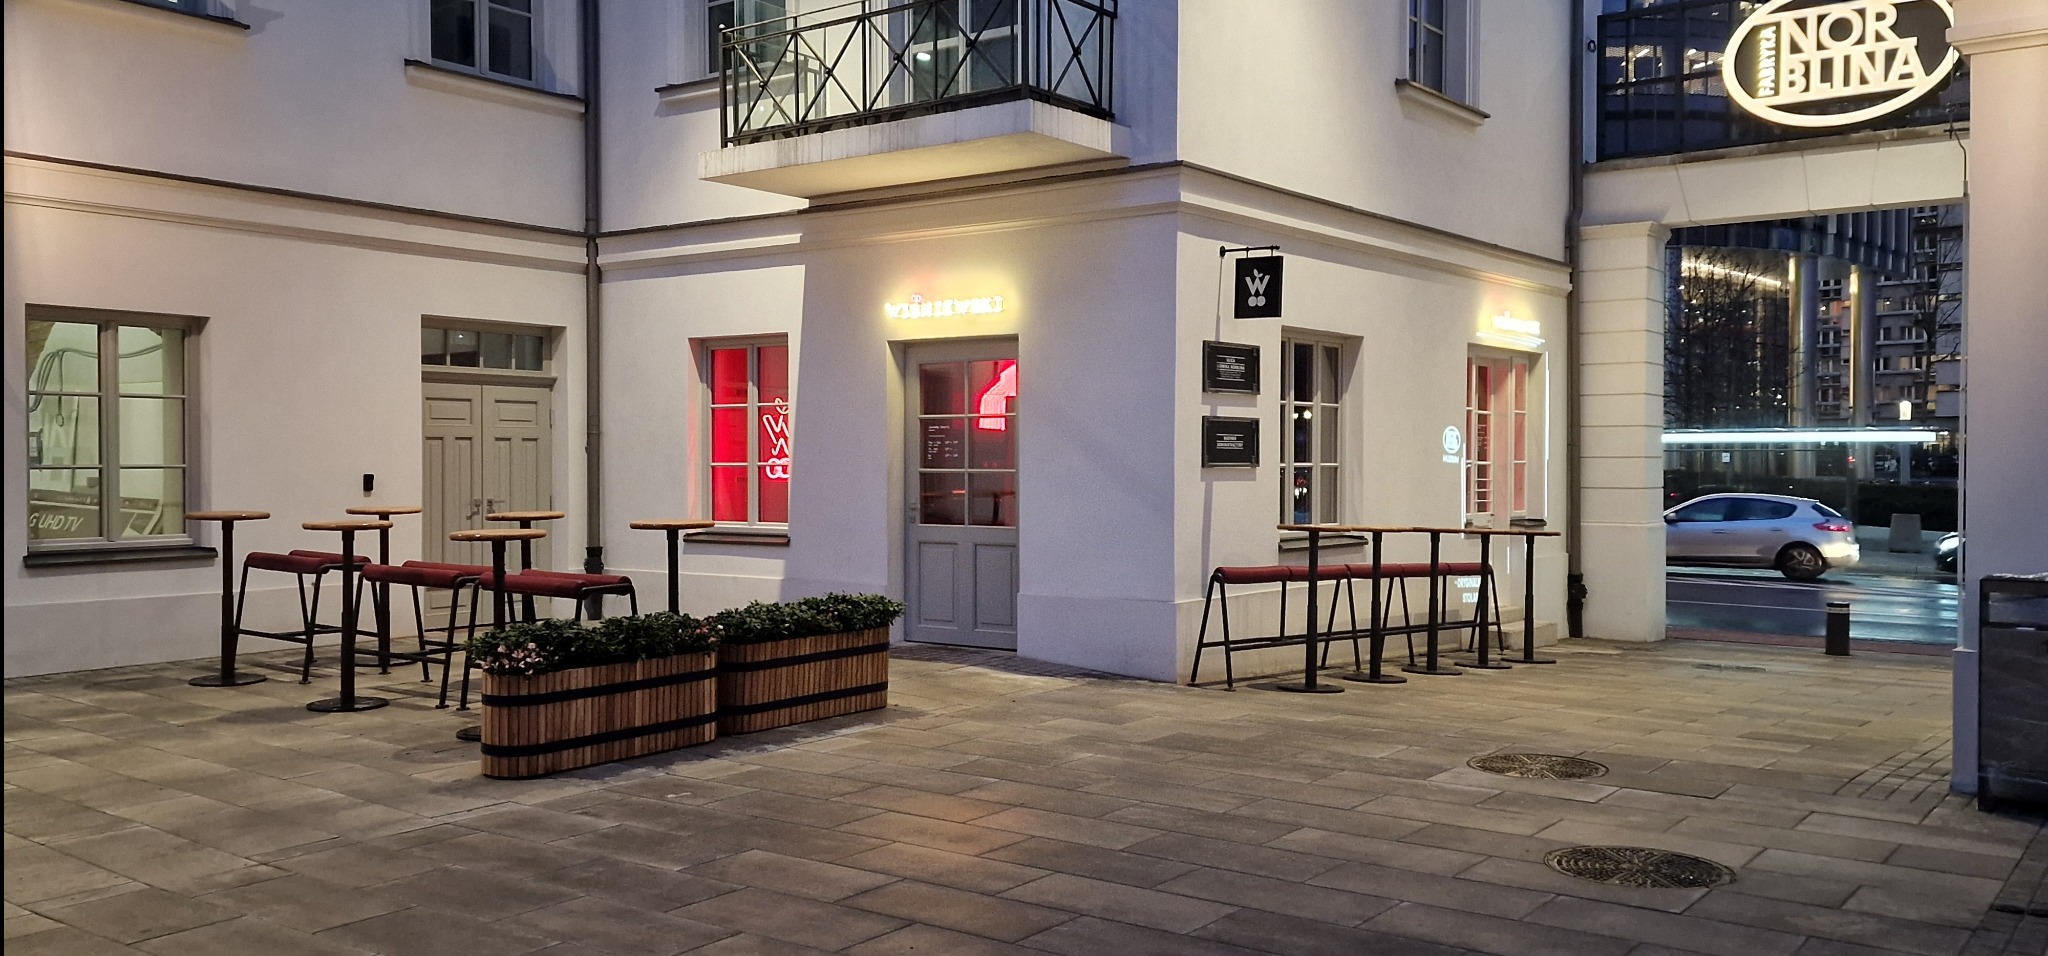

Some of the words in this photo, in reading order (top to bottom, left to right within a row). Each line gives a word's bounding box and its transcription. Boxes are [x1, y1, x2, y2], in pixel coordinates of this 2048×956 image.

[1783, 3, 1900, 57] NOR
[1757, 25, 1777, 98] FABRYKA
[1783, 43, 1930, 95] BLINA
[39, 513, 65, 530] UHD
[64, 516, 84, 532] TV
